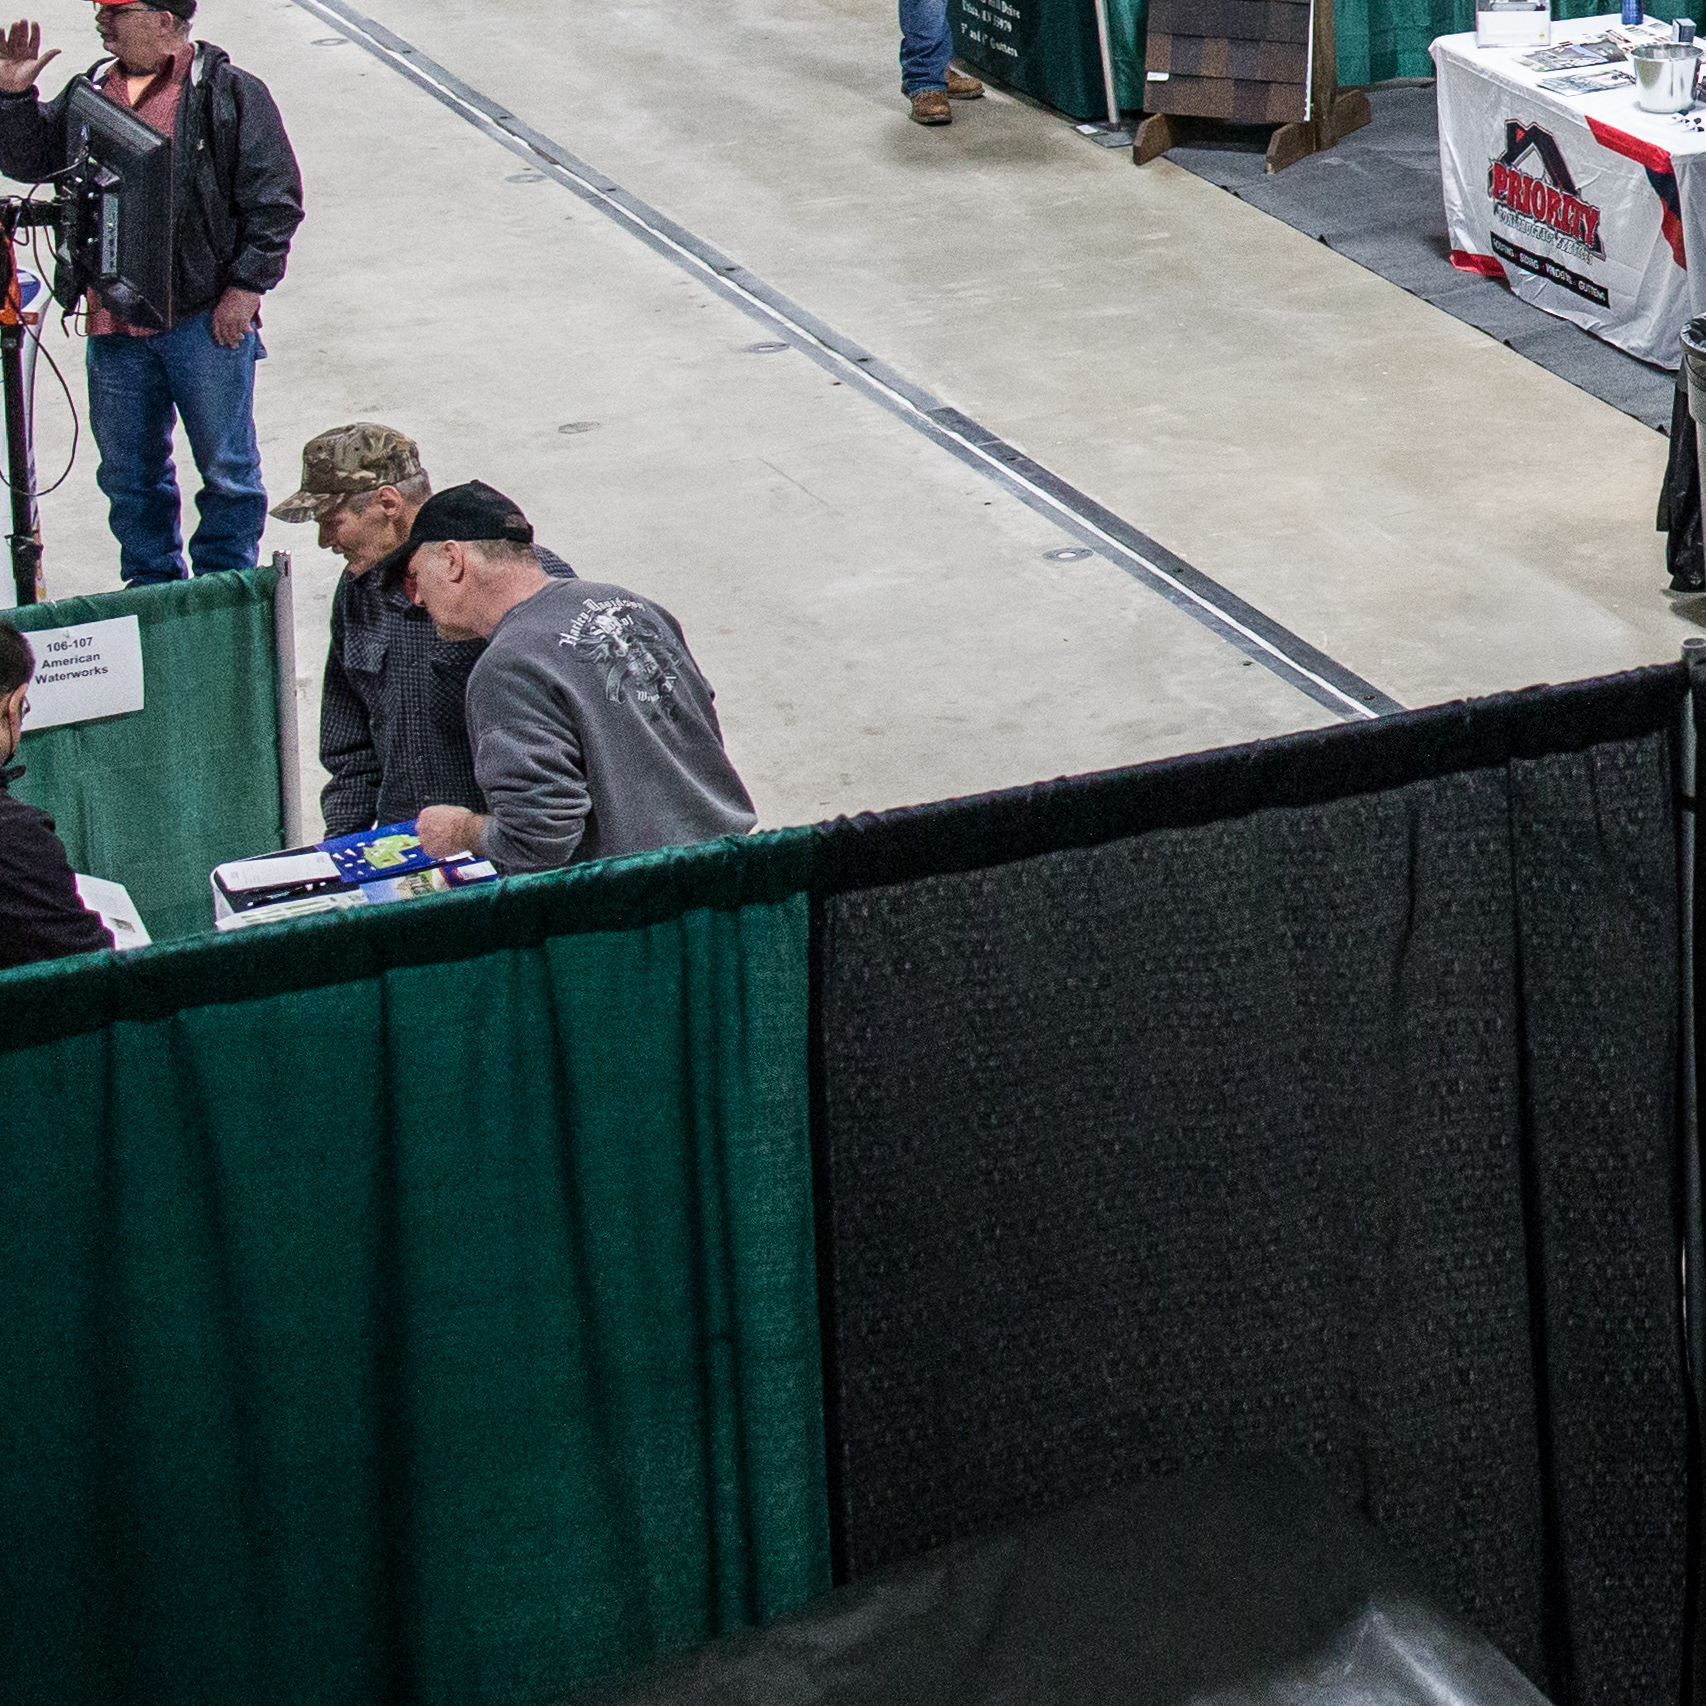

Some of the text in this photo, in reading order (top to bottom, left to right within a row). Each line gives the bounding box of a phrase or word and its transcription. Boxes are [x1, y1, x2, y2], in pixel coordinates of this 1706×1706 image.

[1491, 161, 1602, 246] PRIORITY
[46, 636, 93, 654] 106-107
[41, 651, 101, 672] American
[34, 665, 109, 687] Waterworks
